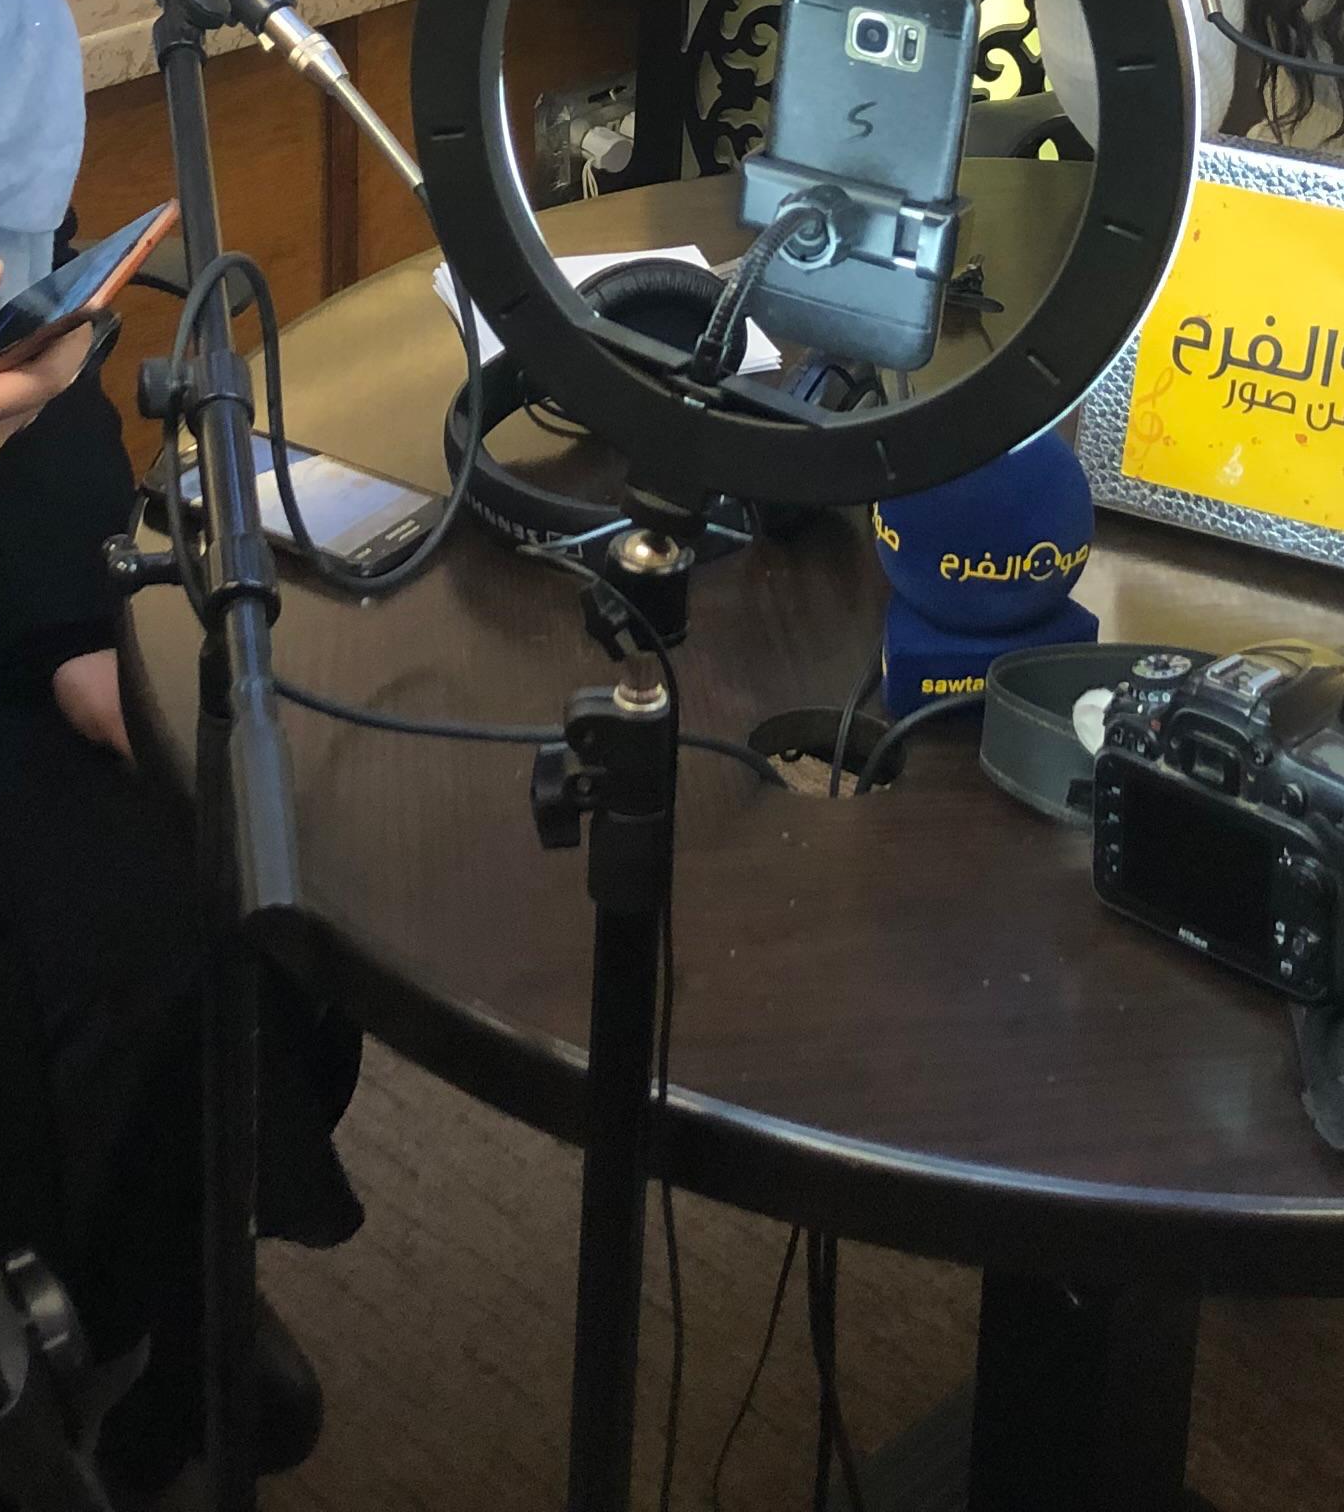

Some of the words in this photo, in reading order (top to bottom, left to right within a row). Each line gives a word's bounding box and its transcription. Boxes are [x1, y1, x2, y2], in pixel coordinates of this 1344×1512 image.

[1171, 315, 1339, 387] الفرح
[1221, 378, 1298, 415] صور
[939, 551, 1022, 582] الفرح
[920, 675, 985, 694] sawta
